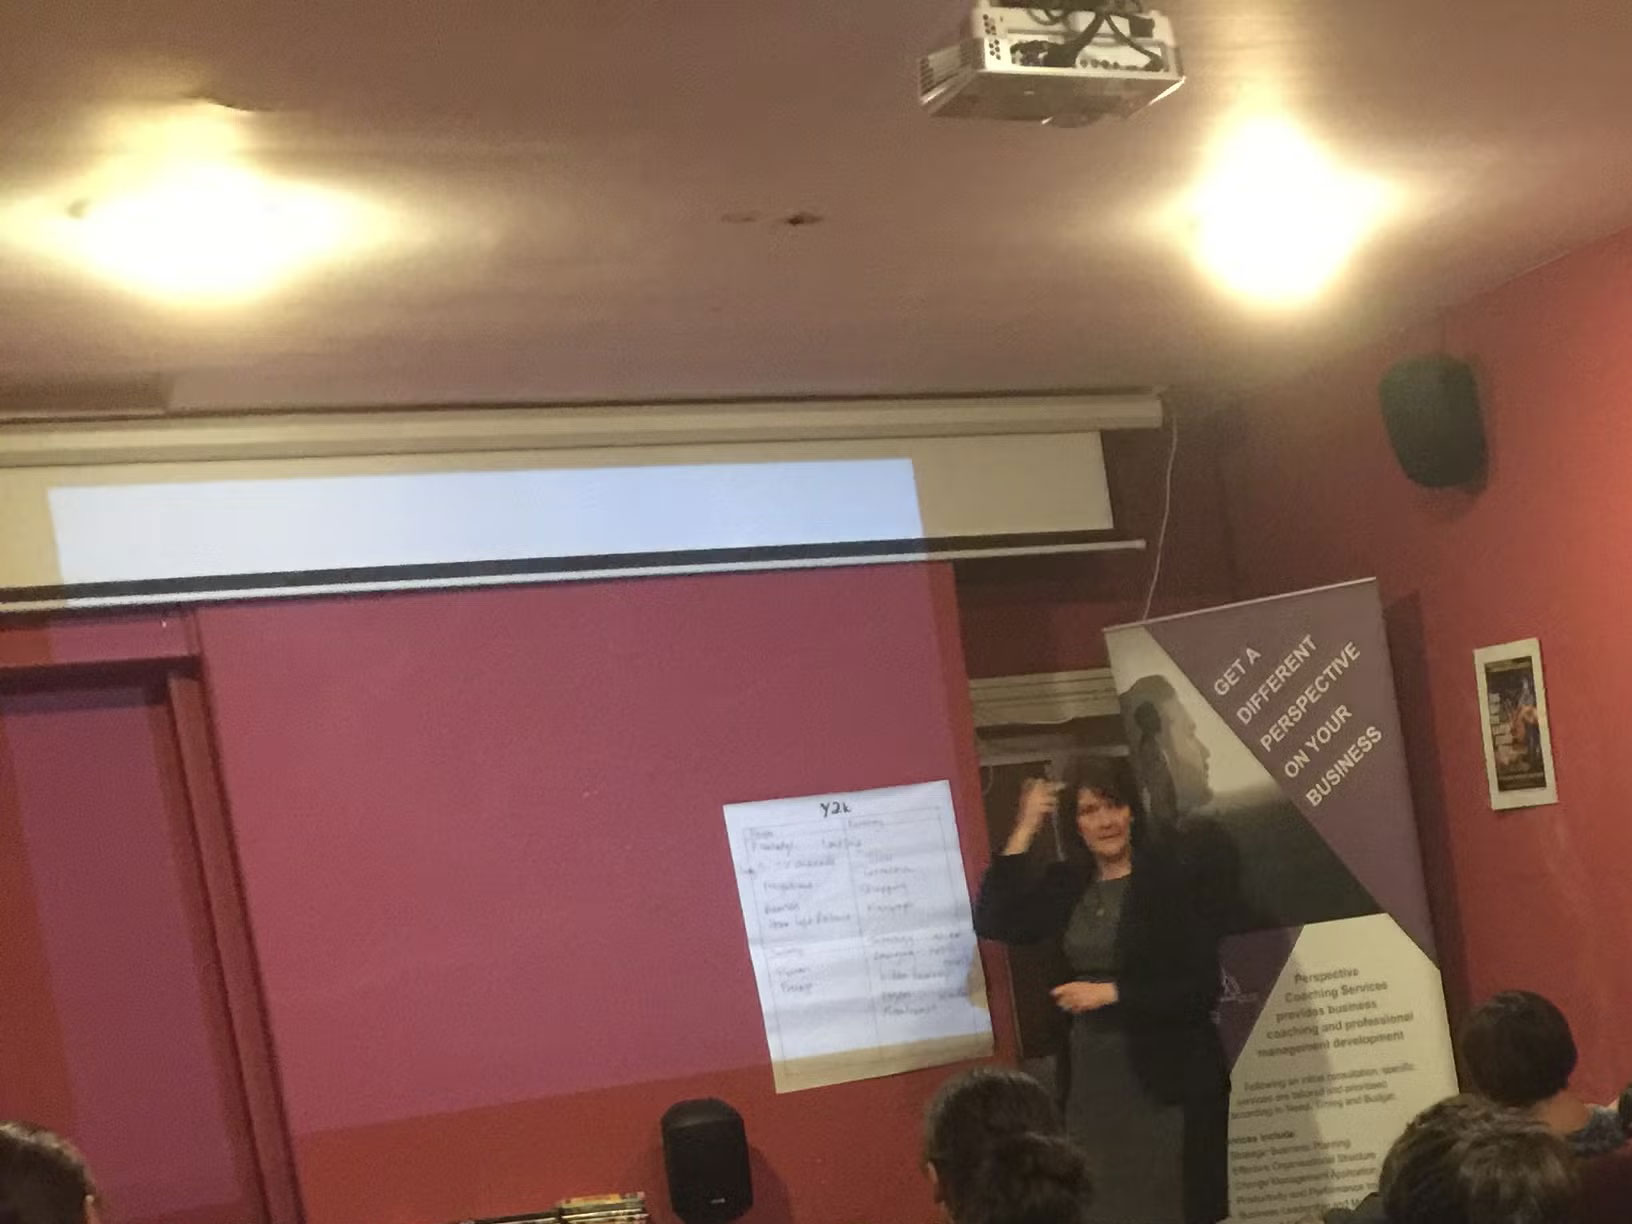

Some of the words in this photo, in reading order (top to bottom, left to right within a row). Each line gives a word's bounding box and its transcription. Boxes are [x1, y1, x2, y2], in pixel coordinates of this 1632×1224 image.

[1214, 659, 1247, 696] GET
[1246, 647, 1261, 666] A
[1236, 634, 1317, 725] DIFFERENT
[1260, 641, 1361, 752] PERSPECTIVE
[1284, 749, 1310, 778] ON
[1305, 704, 1352, 752] YOUR
[1306, 726, 1382, 807] BUSINESS
[1285, 987, 1338, 1003] Coaching
[1341, 980, 1388, 996] Services
[1294, 967, 1359, 984] Perspective
[1266, 1021, 1319, 1040] coaching
[1321, 1021, 1342, 1033] and
[1345, 1012, 1414, 1034] professional
[1276, 1005, 1325, 1023] provides
[1328, 1000, 1378, 1015] business
[1258, 1040, 1330, 1058] management
[1333, 1030, 1404, 1049] development
